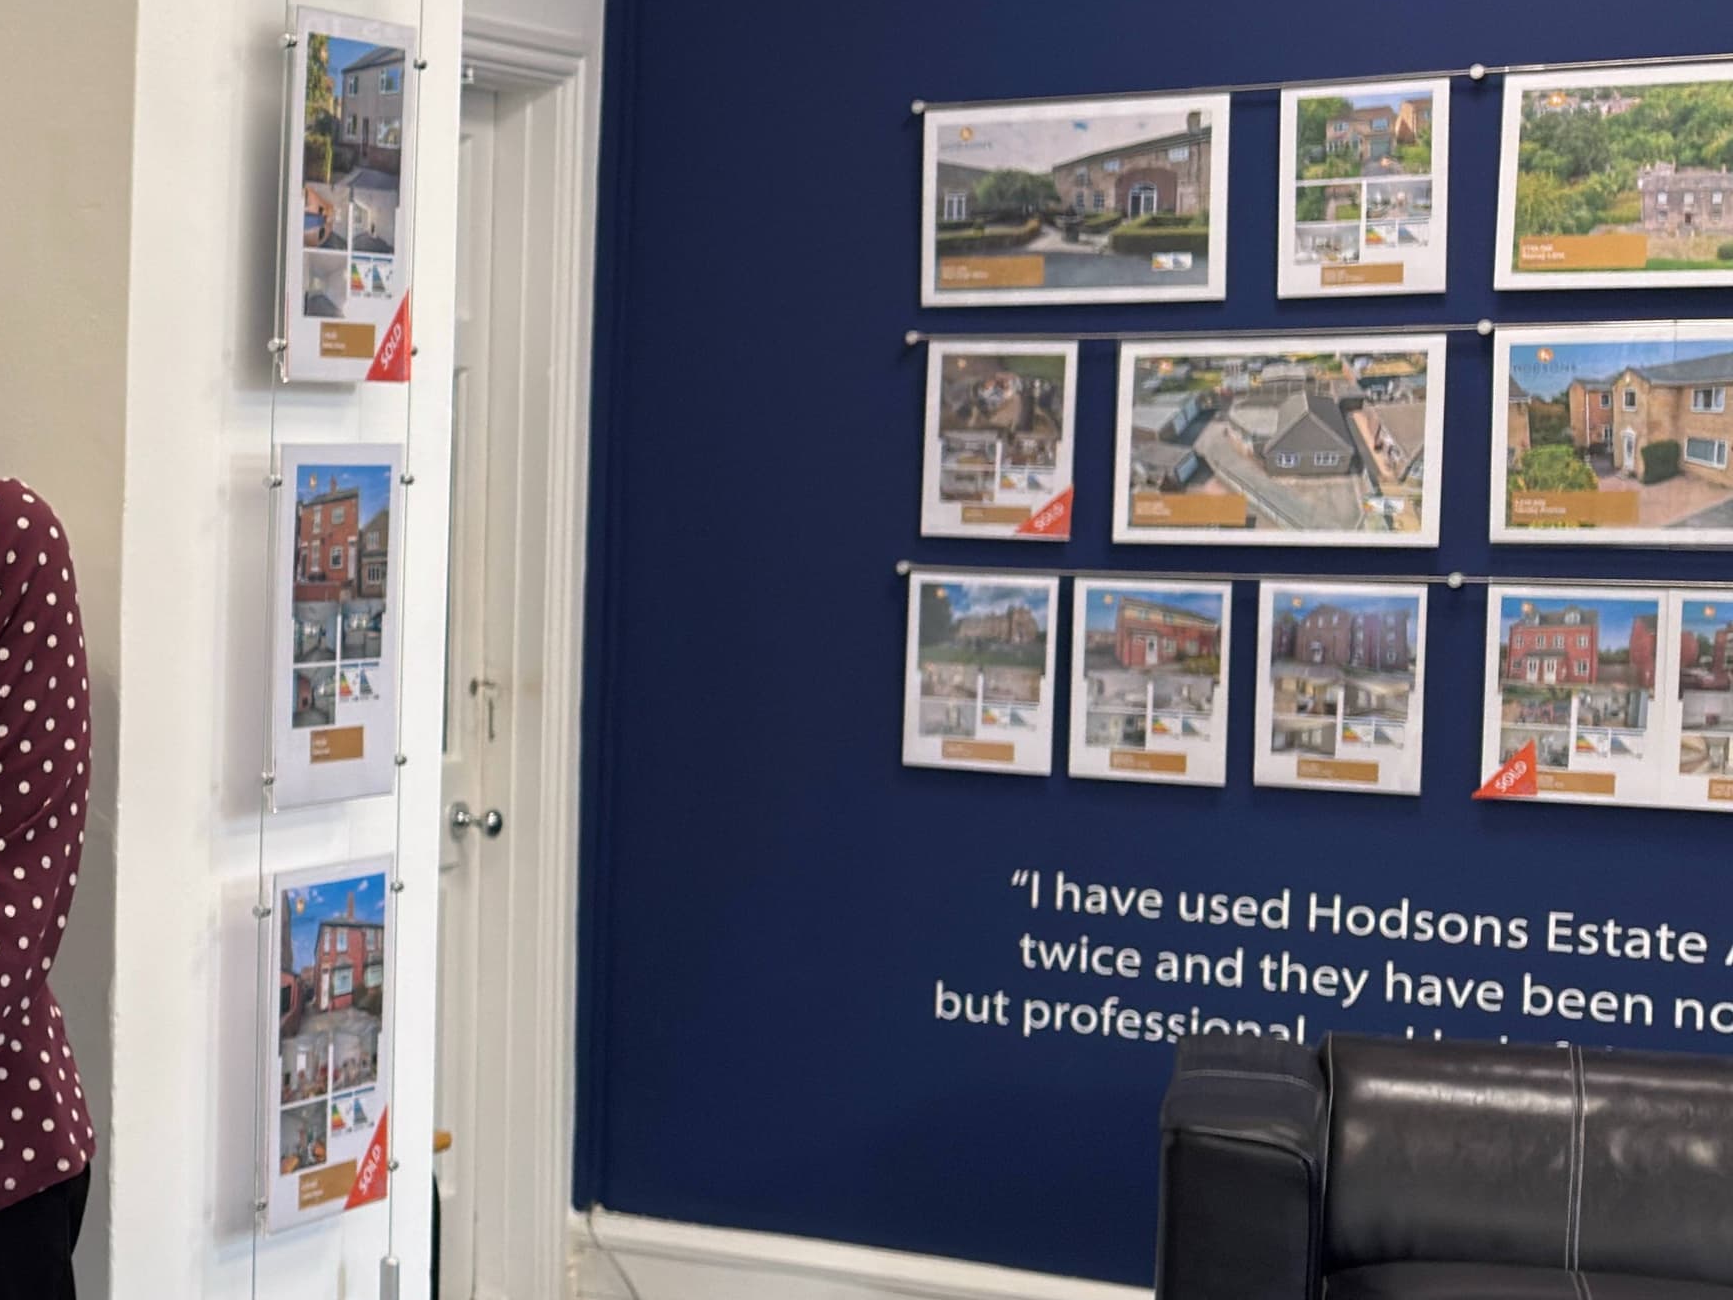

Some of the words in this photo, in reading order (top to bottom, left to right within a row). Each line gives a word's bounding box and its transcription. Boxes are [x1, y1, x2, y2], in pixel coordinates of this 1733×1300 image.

[381, 323, 401, 371] SOLD
[1494, 760, 1527, 792] SOLD
[1011, 869, 1040, 909] “I
[1056, 871, 1163, 919] have
[1179, 888, 1289, 930] used
[1309, 892, 1528, 949] Hodsons
[1547, 911, 1707, 964] Estate
[935, 980, 1010, 1025] but
[1020, 933, 1141, 978] twice
[1155, 947, 1243, 988] and
[1259, 951, 1369, 1008] they
[1385, 960, 1504, 1012] have
[1523, 972, 1653, 1026] been
